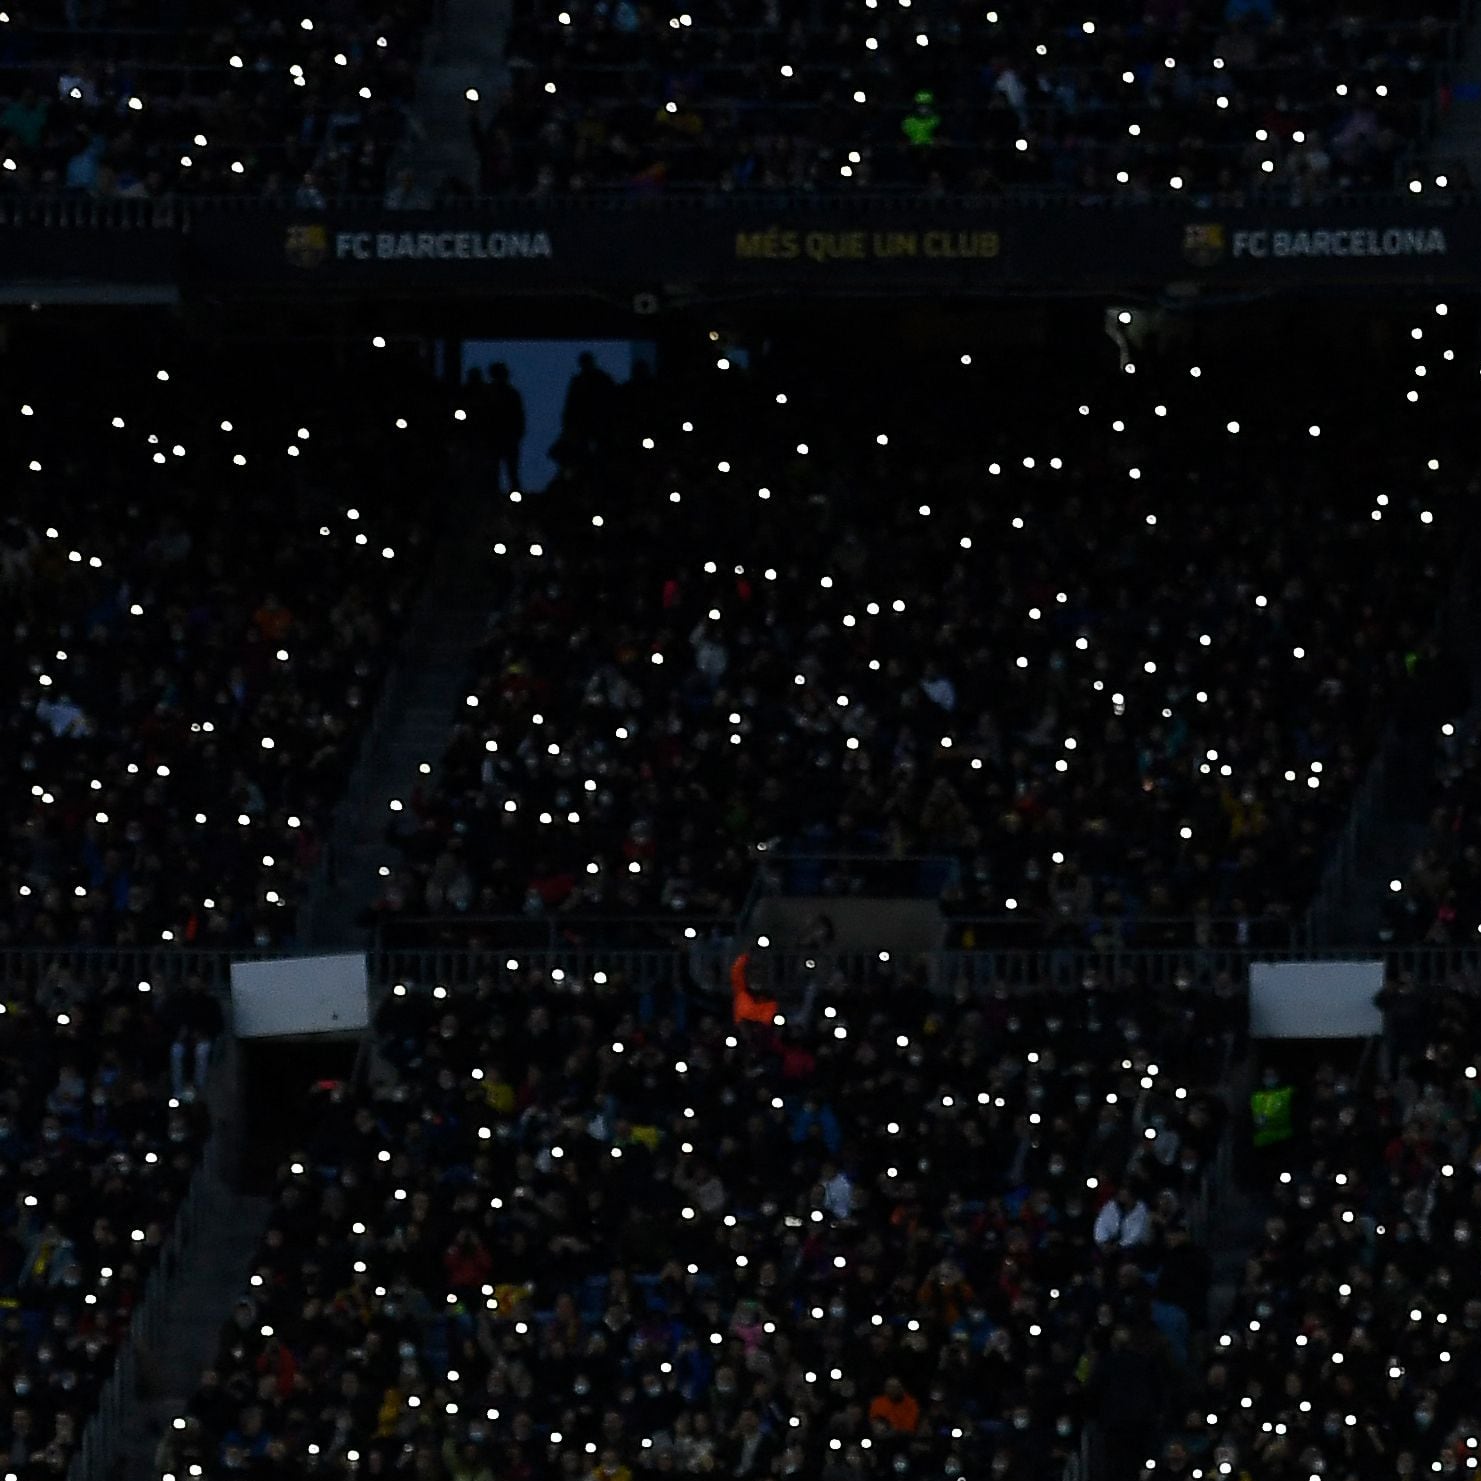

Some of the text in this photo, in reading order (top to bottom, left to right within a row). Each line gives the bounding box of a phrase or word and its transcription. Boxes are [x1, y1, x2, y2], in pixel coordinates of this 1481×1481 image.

[336, 231, 551, 262] FC BARCELONA
[922, 229, 1001, 258] CLUB
[1233, 227, 1446, 257] FC BARCELONA
